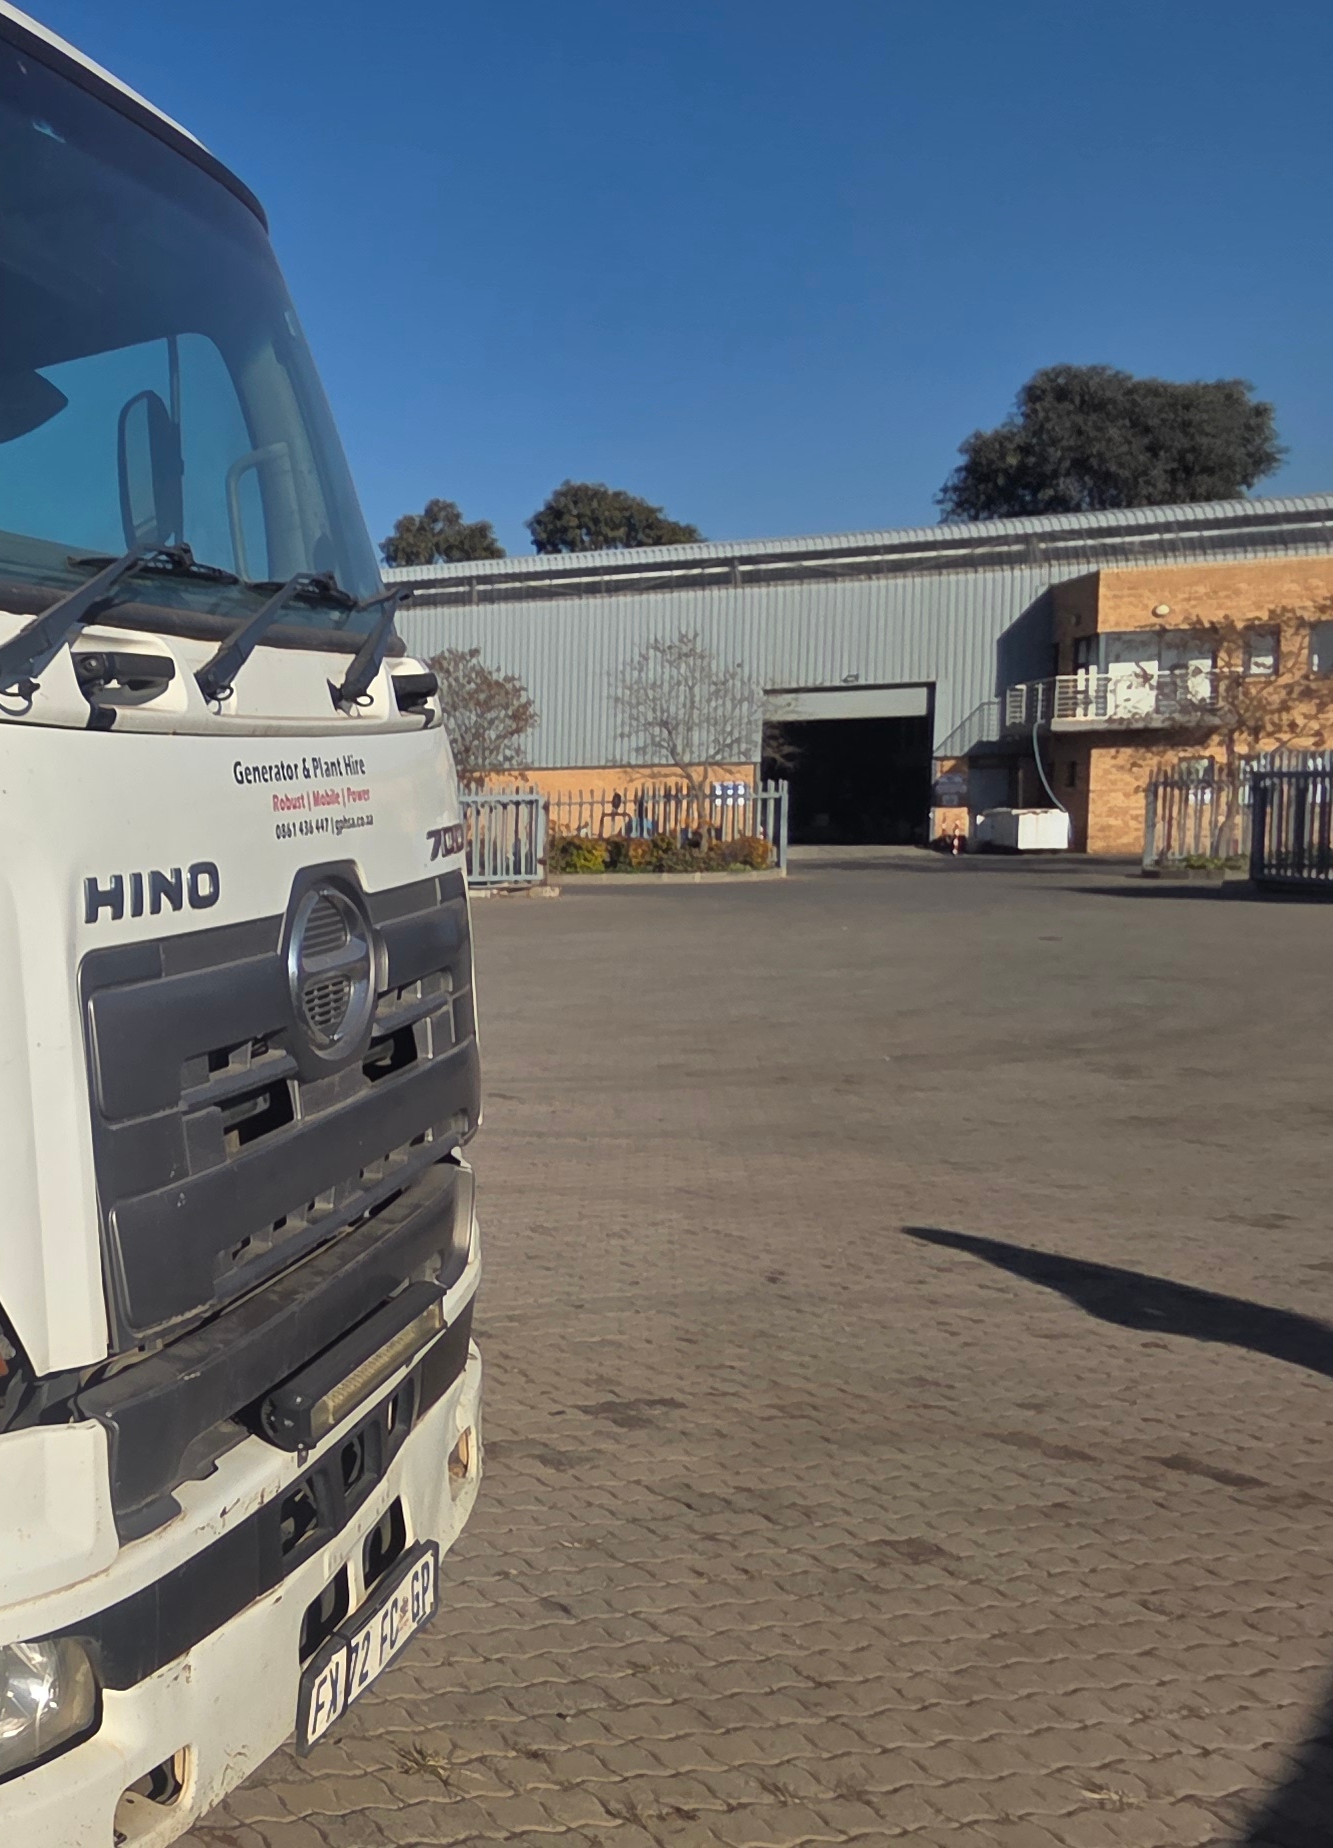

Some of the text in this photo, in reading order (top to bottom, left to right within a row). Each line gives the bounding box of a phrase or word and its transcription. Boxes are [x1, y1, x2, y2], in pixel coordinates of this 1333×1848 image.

[233, 754, 366, 785] Generator & Plant Hire
[272, 793, 306, 812] Robust
[312, 787, 341, 807] Mobile
[346, 786, 370, 804] Power
[315, 817, 329, 834] 447
[426, 823, 464, 862] 700
[84, 861, 220, 924] HINO
[411, 1560, 430, 1624] GP
